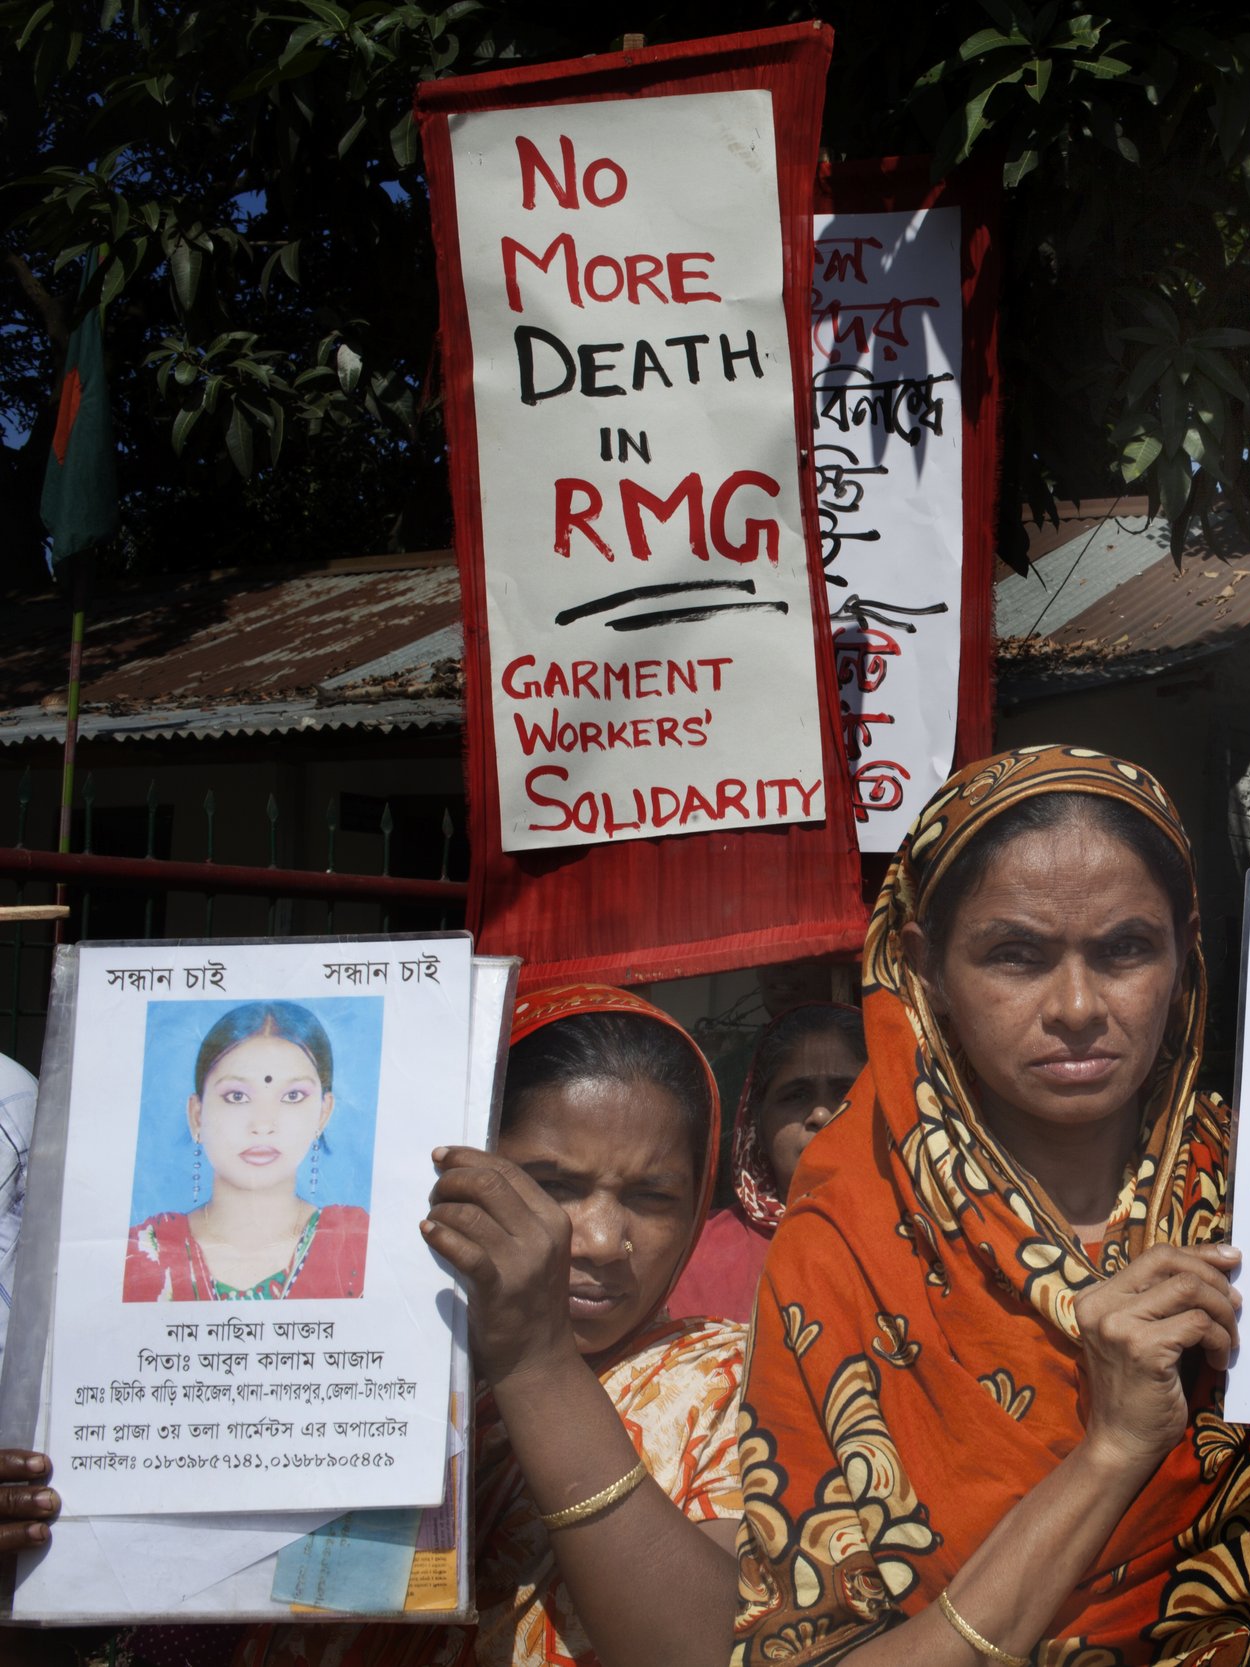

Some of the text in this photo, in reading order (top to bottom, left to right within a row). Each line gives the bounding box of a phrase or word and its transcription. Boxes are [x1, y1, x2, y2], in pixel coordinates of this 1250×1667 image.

[600, 428, 651, 463] IN
[553, 470, 780, 564] RMG
[502, 655, 732, 700] GARMENT
[106, 960, 226, 991] সন্ধান চাই
[323, 953, 440, 985] সন্ধান চাই
[167, 1317, 334, 1342] নাম নাছিমা আক্তার
[138, 1348, 384, 1375] পিতাঃ আবুল কালাম আজাদ
[75, 1387, 105, 1405] গ্রামঃ
[110, 1380, 145, 1403] ছিটকি
[151, 1379, 177, 1405] বাড়ি
[74, 1417, 408, 1442] রানা প্লাজা ৩য় তলা গার্মেন্টস এর অপারেটর
[72, 1452, 136, 1470] মোবাইলঃ
